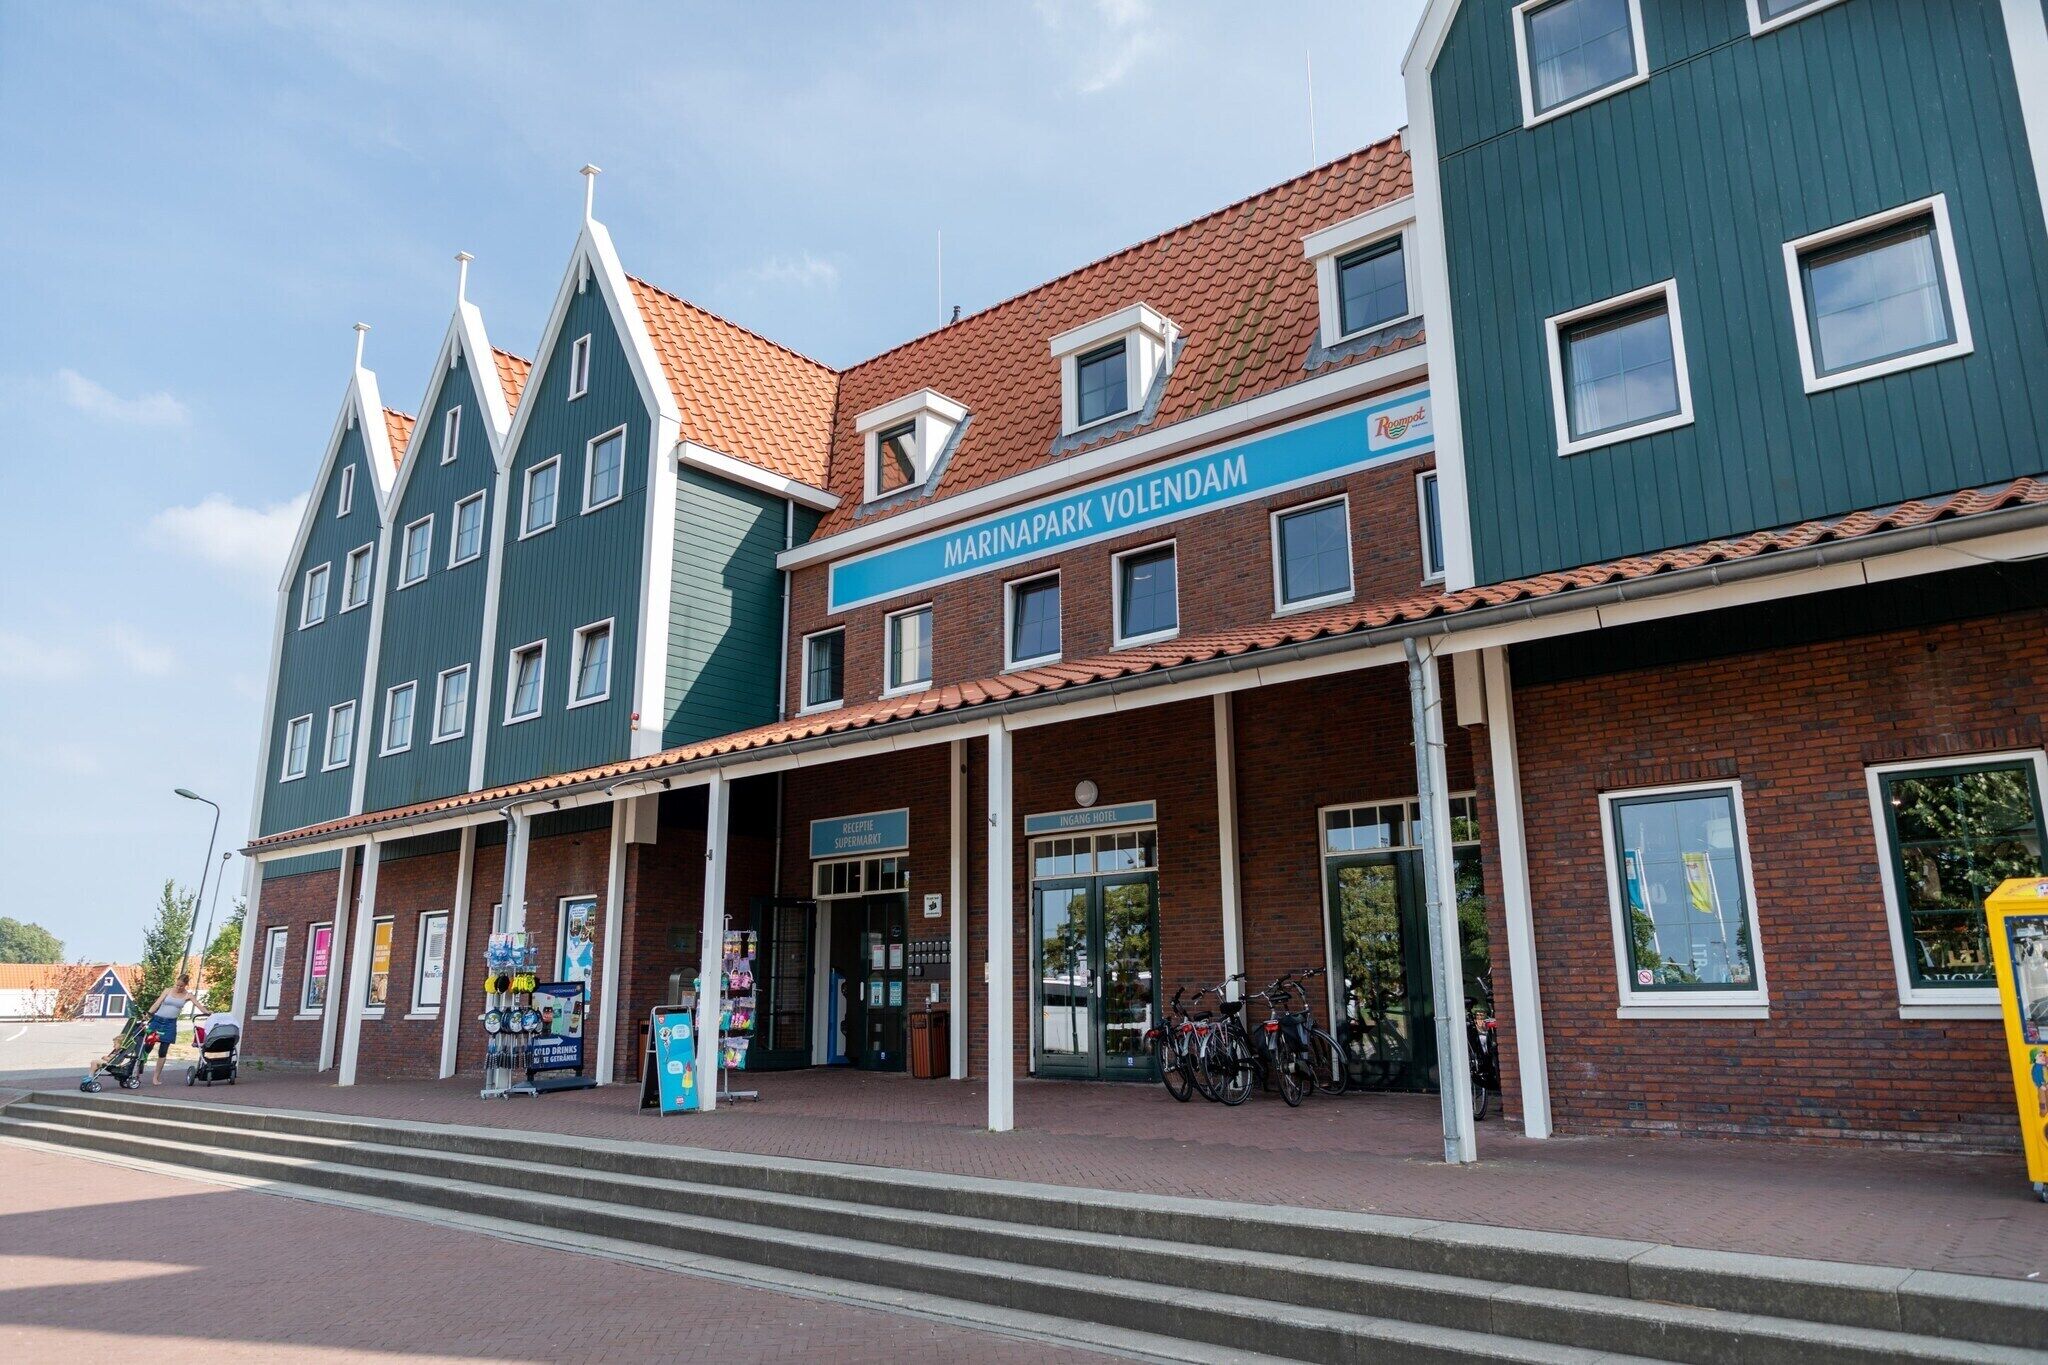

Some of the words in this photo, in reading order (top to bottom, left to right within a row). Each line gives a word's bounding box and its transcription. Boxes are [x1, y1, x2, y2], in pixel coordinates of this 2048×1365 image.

[1375, 406, 1426, 440] Roompot
[943, 499, 1093, 568] MARINAPARK
[1101, 454, 1248, 523] VOLENDAM
[1060, 814, 1091, 827] INGANG
[1093, 810, 1117, 823] HOTEL
[842, 820, 874, 834] RECEPTIE
[834, 833, 881, 849] SUPERMARKT
[534, 1047, 551, 1056] COLD
[551, 1045, 578, 1055] DRINKS
[549, 1054, 577, 1063] GETRÄNKE
